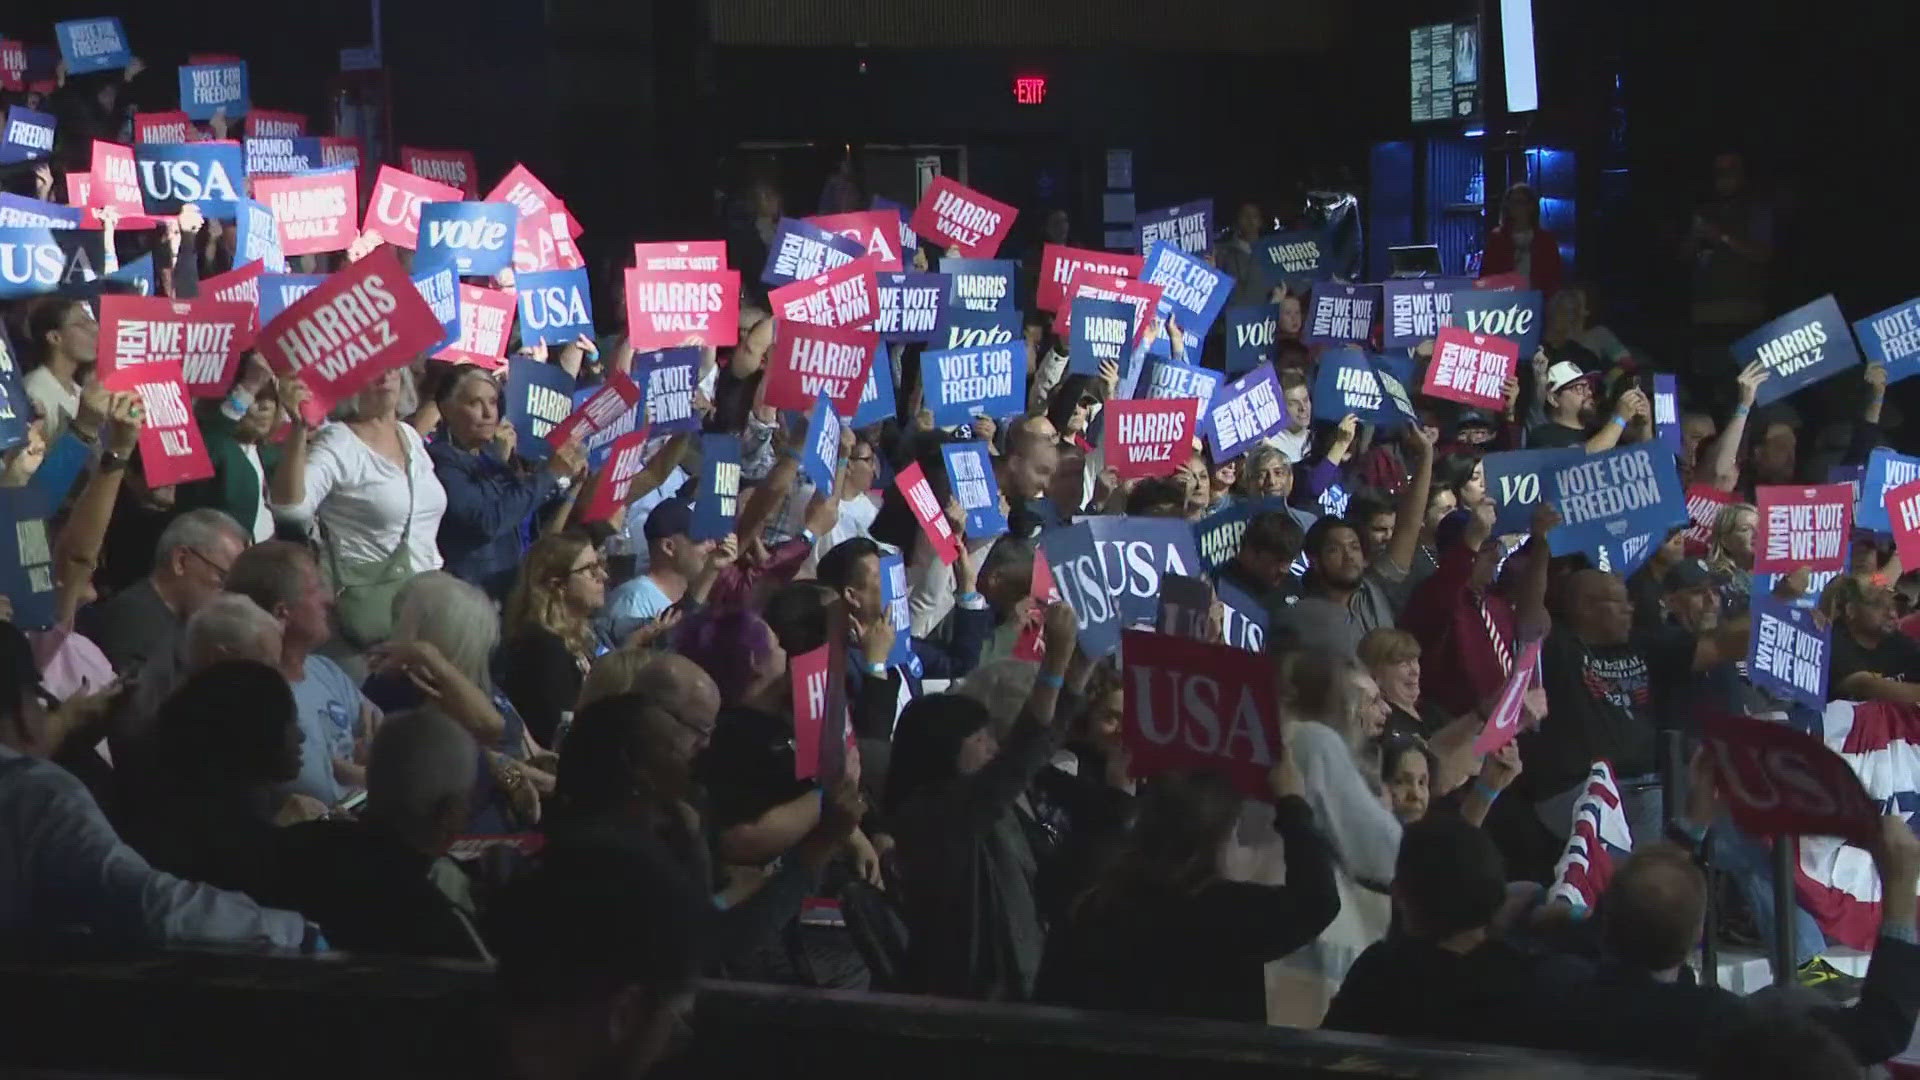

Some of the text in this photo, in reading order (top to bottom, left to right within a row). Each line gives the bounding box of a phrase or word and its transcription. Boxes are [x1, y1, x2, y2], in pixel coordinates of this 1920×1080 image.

[192, 67, 241, 88] VOTE FOR
[1017, 79, 1045, 104] EXIT
[194, 85, 241, 104] FREEDOM
[143, 123, 187, 145] HARRIS
[255, 118, 300, 137] HARRIS
[246, 138, 293, 156] CUANDO
[246, 155, 310, 173] LUCHAMOS
[411, 156, 467, 184] HARRIS
[140, 160, 239, 202] USA
[270, 185, 348, 223] HARRIS
[376, 182, 432, 235] US
[932, 189, 1002, 237] HARRIS
[285, 216, 340, 241] WALZ
[429, 216, 508, 251] vote
[935, 215, 982, 248] WALZ
[1158, 212, 1206, 241] WE VOTE
[1181, 230, 1207, 253] WIN
[0, 243, 97, 286] USA
[1267, 240, 1321, 265] HARRIS
[1282, 258, 1319, 274] WALZ
[956, 274, 1008, 299] HARRIS
[1157, 248, 1192, 281] VOTE
[1186, 264, 1219, 297] FOR
[520, 284, 591, 331] USA
[639, 282, 724, 313] HARRIS
[805, 273, 867, 318] WE VOTE
[877, 287, 940, 310] WE VOTE
[964, 298, 1000, 313] WALZ
[1148, 268, 1210, 316] FREEDOM
[1333, 297, 1374, 319] WE VOTE
[1412, 293, 1435, 315] WE
[276, 274, 397, 372] HARRIS
[650, 312, 710, 333] WALZ
[835, 294, 871, 327] WIN
[902, 308, 938, 331] WIN
[1312, 296, 1335, 337] WHEN
[1392, 294, 1413, 337] WHEN
[1413, 313, 1437, 337] WE
[1465, 303, 1534, 336] vote
[1871, 308, 1917, 341] VOTE
[149, 321, 236, 353] WE VOTE
[1083, 316, 1128, 346] HARRIS
[1235, 316, 1277, 350] vote
[1330, 317, 1351, 339] WE
[314, 318, 399, 383] WALZ
[789, 336, 866, 380] HARRIS
[1091, 343, 1122, 361] WALZ
[1756, 319, 1829, 370] HARRIS
[1880, 328, 1920, 363] FREE
[182, 352, 228, 385] WIN
[938, 349, 1013, 381] VOTE FOR
[1151, 362, 1192, 391] VOTE
[1458, 346, 1510, 377] WE VOTE
[1773, 346, 1825, 379] WALZ
[801, 374, 851, 400] WALZ
[940, 373, 1012, 406] FREEDOM
[1452, 366, 1478, 394] WE
[1343, 391, 1384, 411] WALZ
[1118, 411, 1186, 445] HARRIS
[1127, 443, 1173, 463] WALZ
[1556, 449, 1654, 498] VOTE FOR
[1559, 477, 1662, 526] FREEDOM
[1789, 503, 1845, 531] WE VOTE
[1766, 504, 1790, 561] WHEN
[1789, 529, 1842, 561] WE WIN
[1094, 541, 1189, 599] USA
[1053, 555, 1119, 631] US
[1755, 612, 1778, 672] WHEN
[1776, 619, 1824, 667] WE VOTE
[1771, 647, 1821, 696] WE WIN
[1130, 664, 1273, 768] USA
